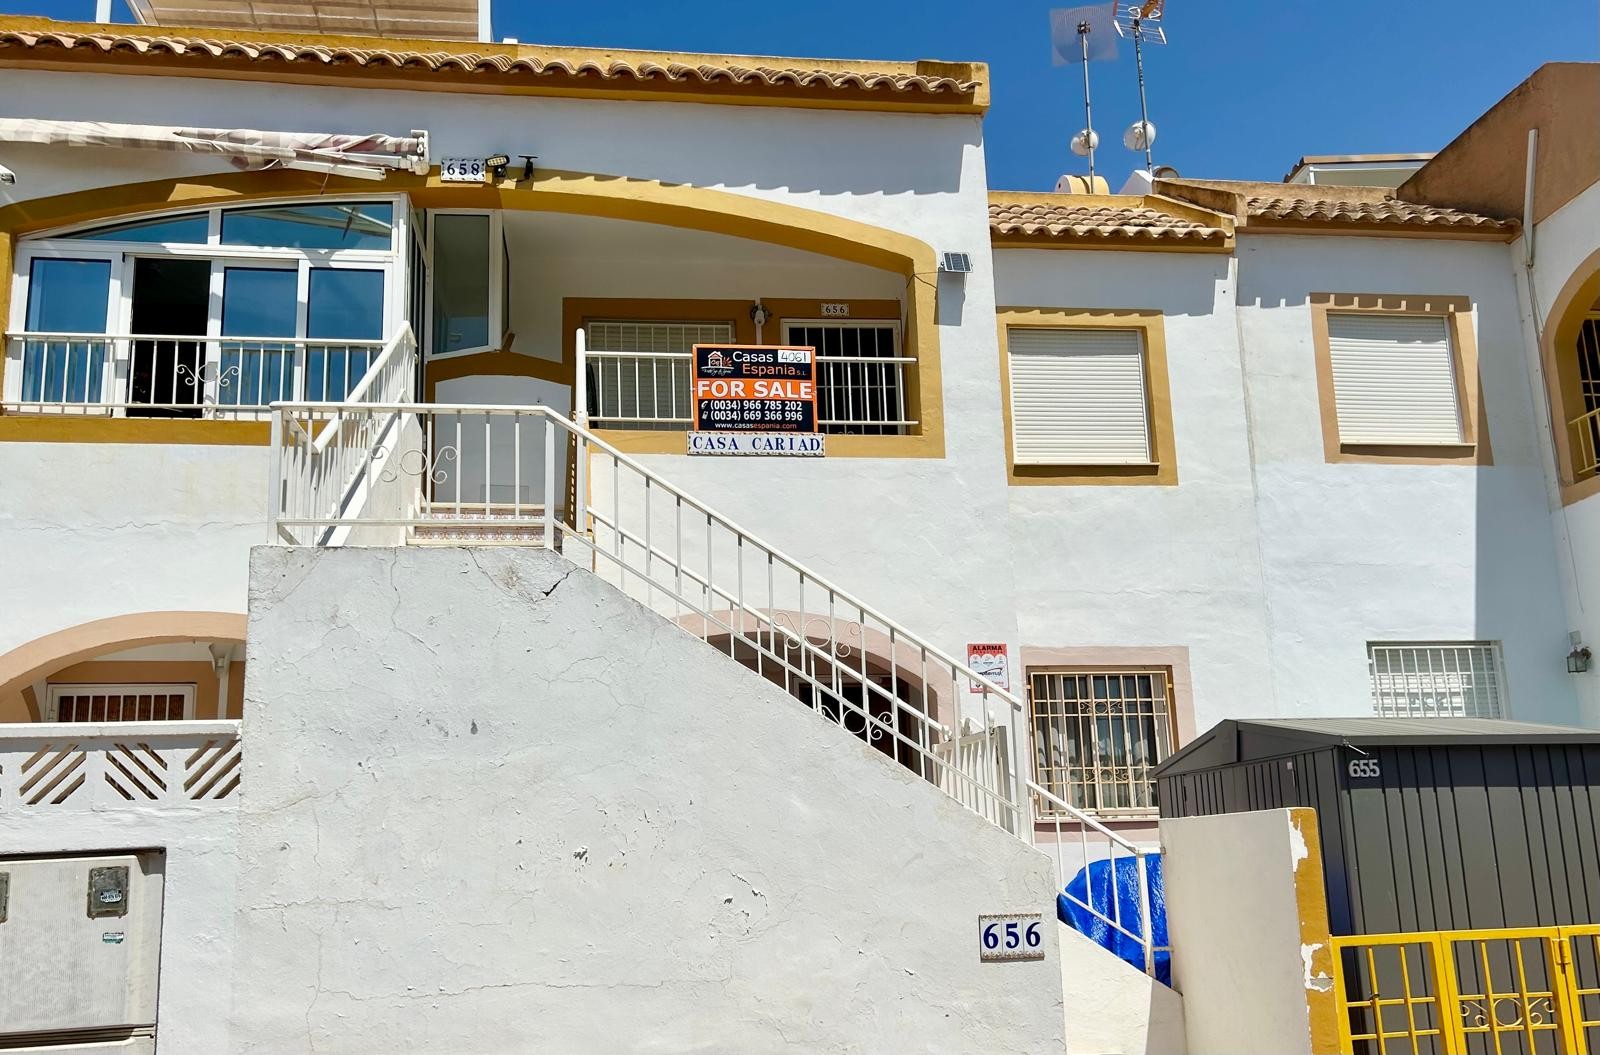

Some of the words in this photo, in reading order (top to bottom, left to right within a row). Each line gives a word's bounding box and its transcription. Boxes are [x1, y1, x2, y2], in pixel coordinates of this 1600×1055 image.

[447, 163, 480, 175] 658
[825, 305, 845, 313] 656
[732, 351, 774, 363] Casas
[742, 363, 796, 377] Espania
[697, 380, 746, 398] FOR
[753, 381, 813, 399] SALE
[710, 400, 741, 410] (0034)
[743, 400, 762, 410] 966
[763, 401, 782, 410] 785
[784, 401, 803, 411] 202
[710, 411, 741, 420] (0034)
[743, 411, 762, 420] 669
[764, 411, 783, 420] 366
[784, 411, 803, 421] 996
[692, 436, 739, 450] CASA
[751, 437, 821, 451] CARIAD
[1348, 759, 1380, 778] 655
[983, 921, 1041, 949] 656
